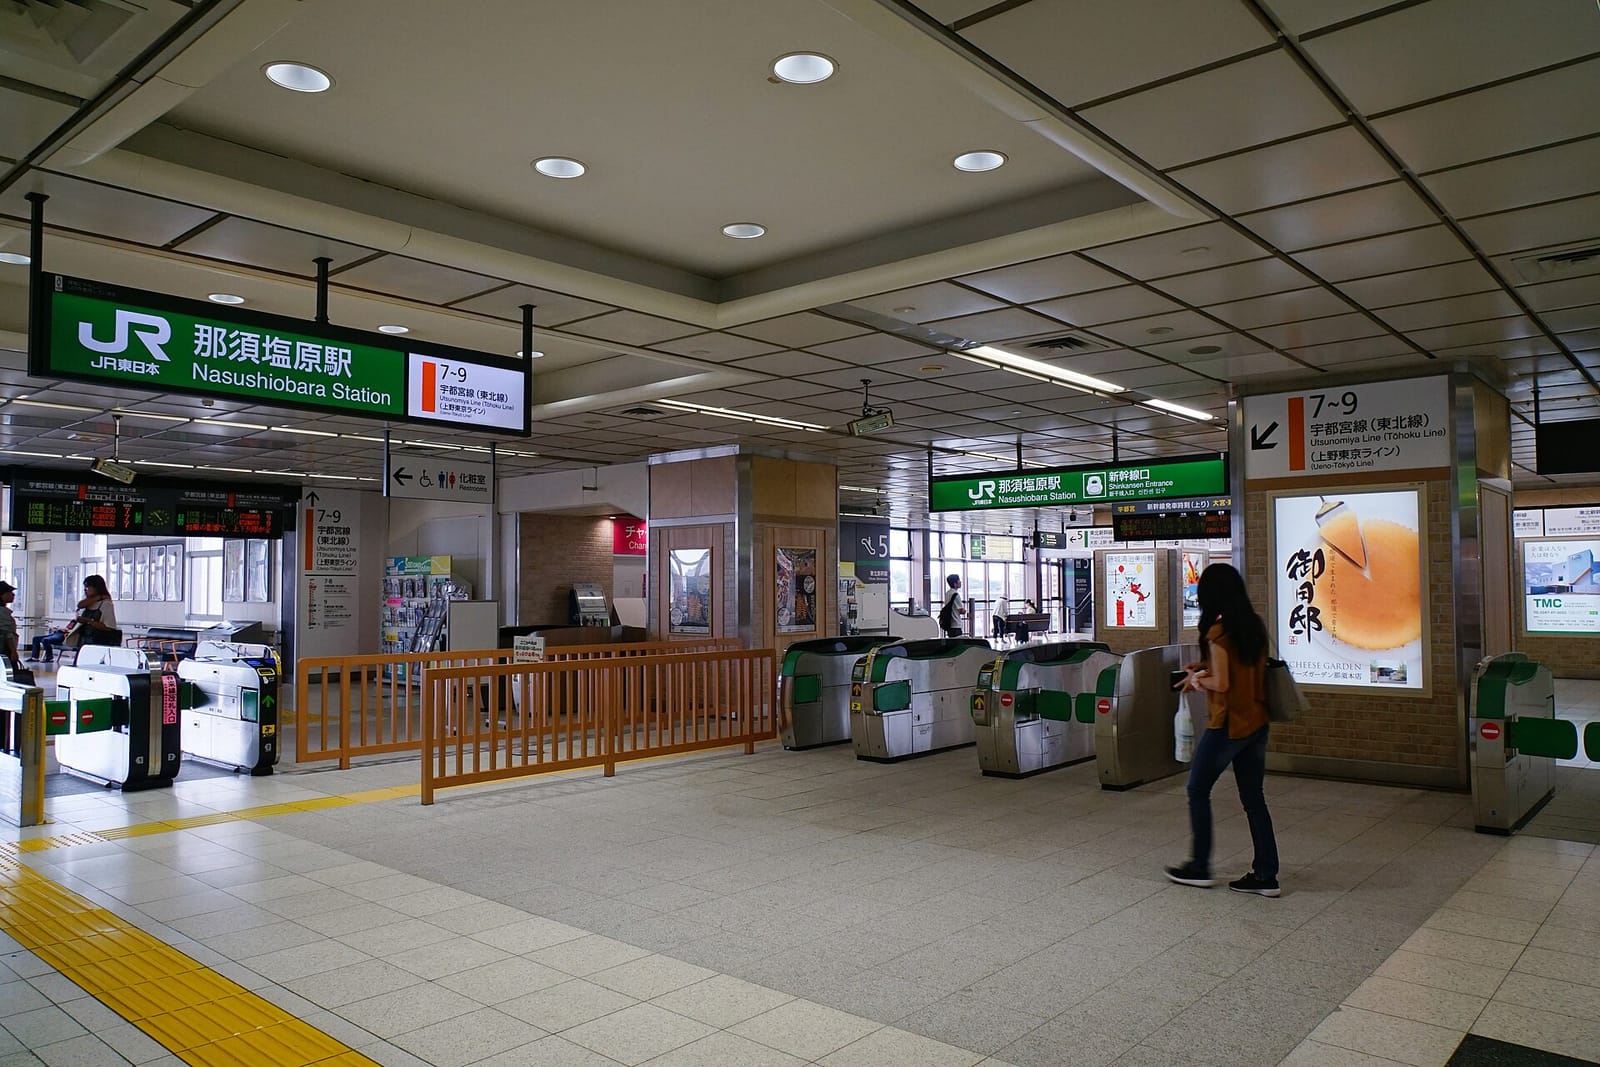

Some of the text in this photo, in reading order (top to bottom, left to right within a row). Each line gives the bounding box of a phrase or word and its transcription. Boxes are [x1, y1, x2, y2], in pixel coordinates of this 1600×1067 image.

[78, 309, 172, 362] JR
[194, 323, 352, 379] 那須塩原駅
[90, 356, 160, 376] JR東日本
[192, 362, 391, 406] Nasushiobara Station
[1310, 437, 1360, 447] Utsunomiya
[1362, 434, 1381, 443] Line
[1424, 428, 1446, 438] Line)
[1311, 444, 1400, 462] （上野東京ライン）
[1356, 459, 1374, 468] Line)
[460, 472, 486, 485] 化粧室
[1108, 469, 1149, 482] 新幹線口
[459, 484, 488, 492] Restrooms
[968, 480, 996, 499] JR
[998, 476, 1061, 494] 那須塩原駅
[998, 492, 1076, 504] Nasushiobara Station
[317, 526, 351, 536] 宇都宮線
[626, 525, 646, 539] チャ
[1078, 530, 1083, 539] 5
[629, 541, 646, 550] Chan
[879, 535, 888, 558] 5
[1286, 548, 1326, 644] 御用邸
[1533, 598, 1562, 608] TMC
[1323, 662, 1361, 670] GARDEN
